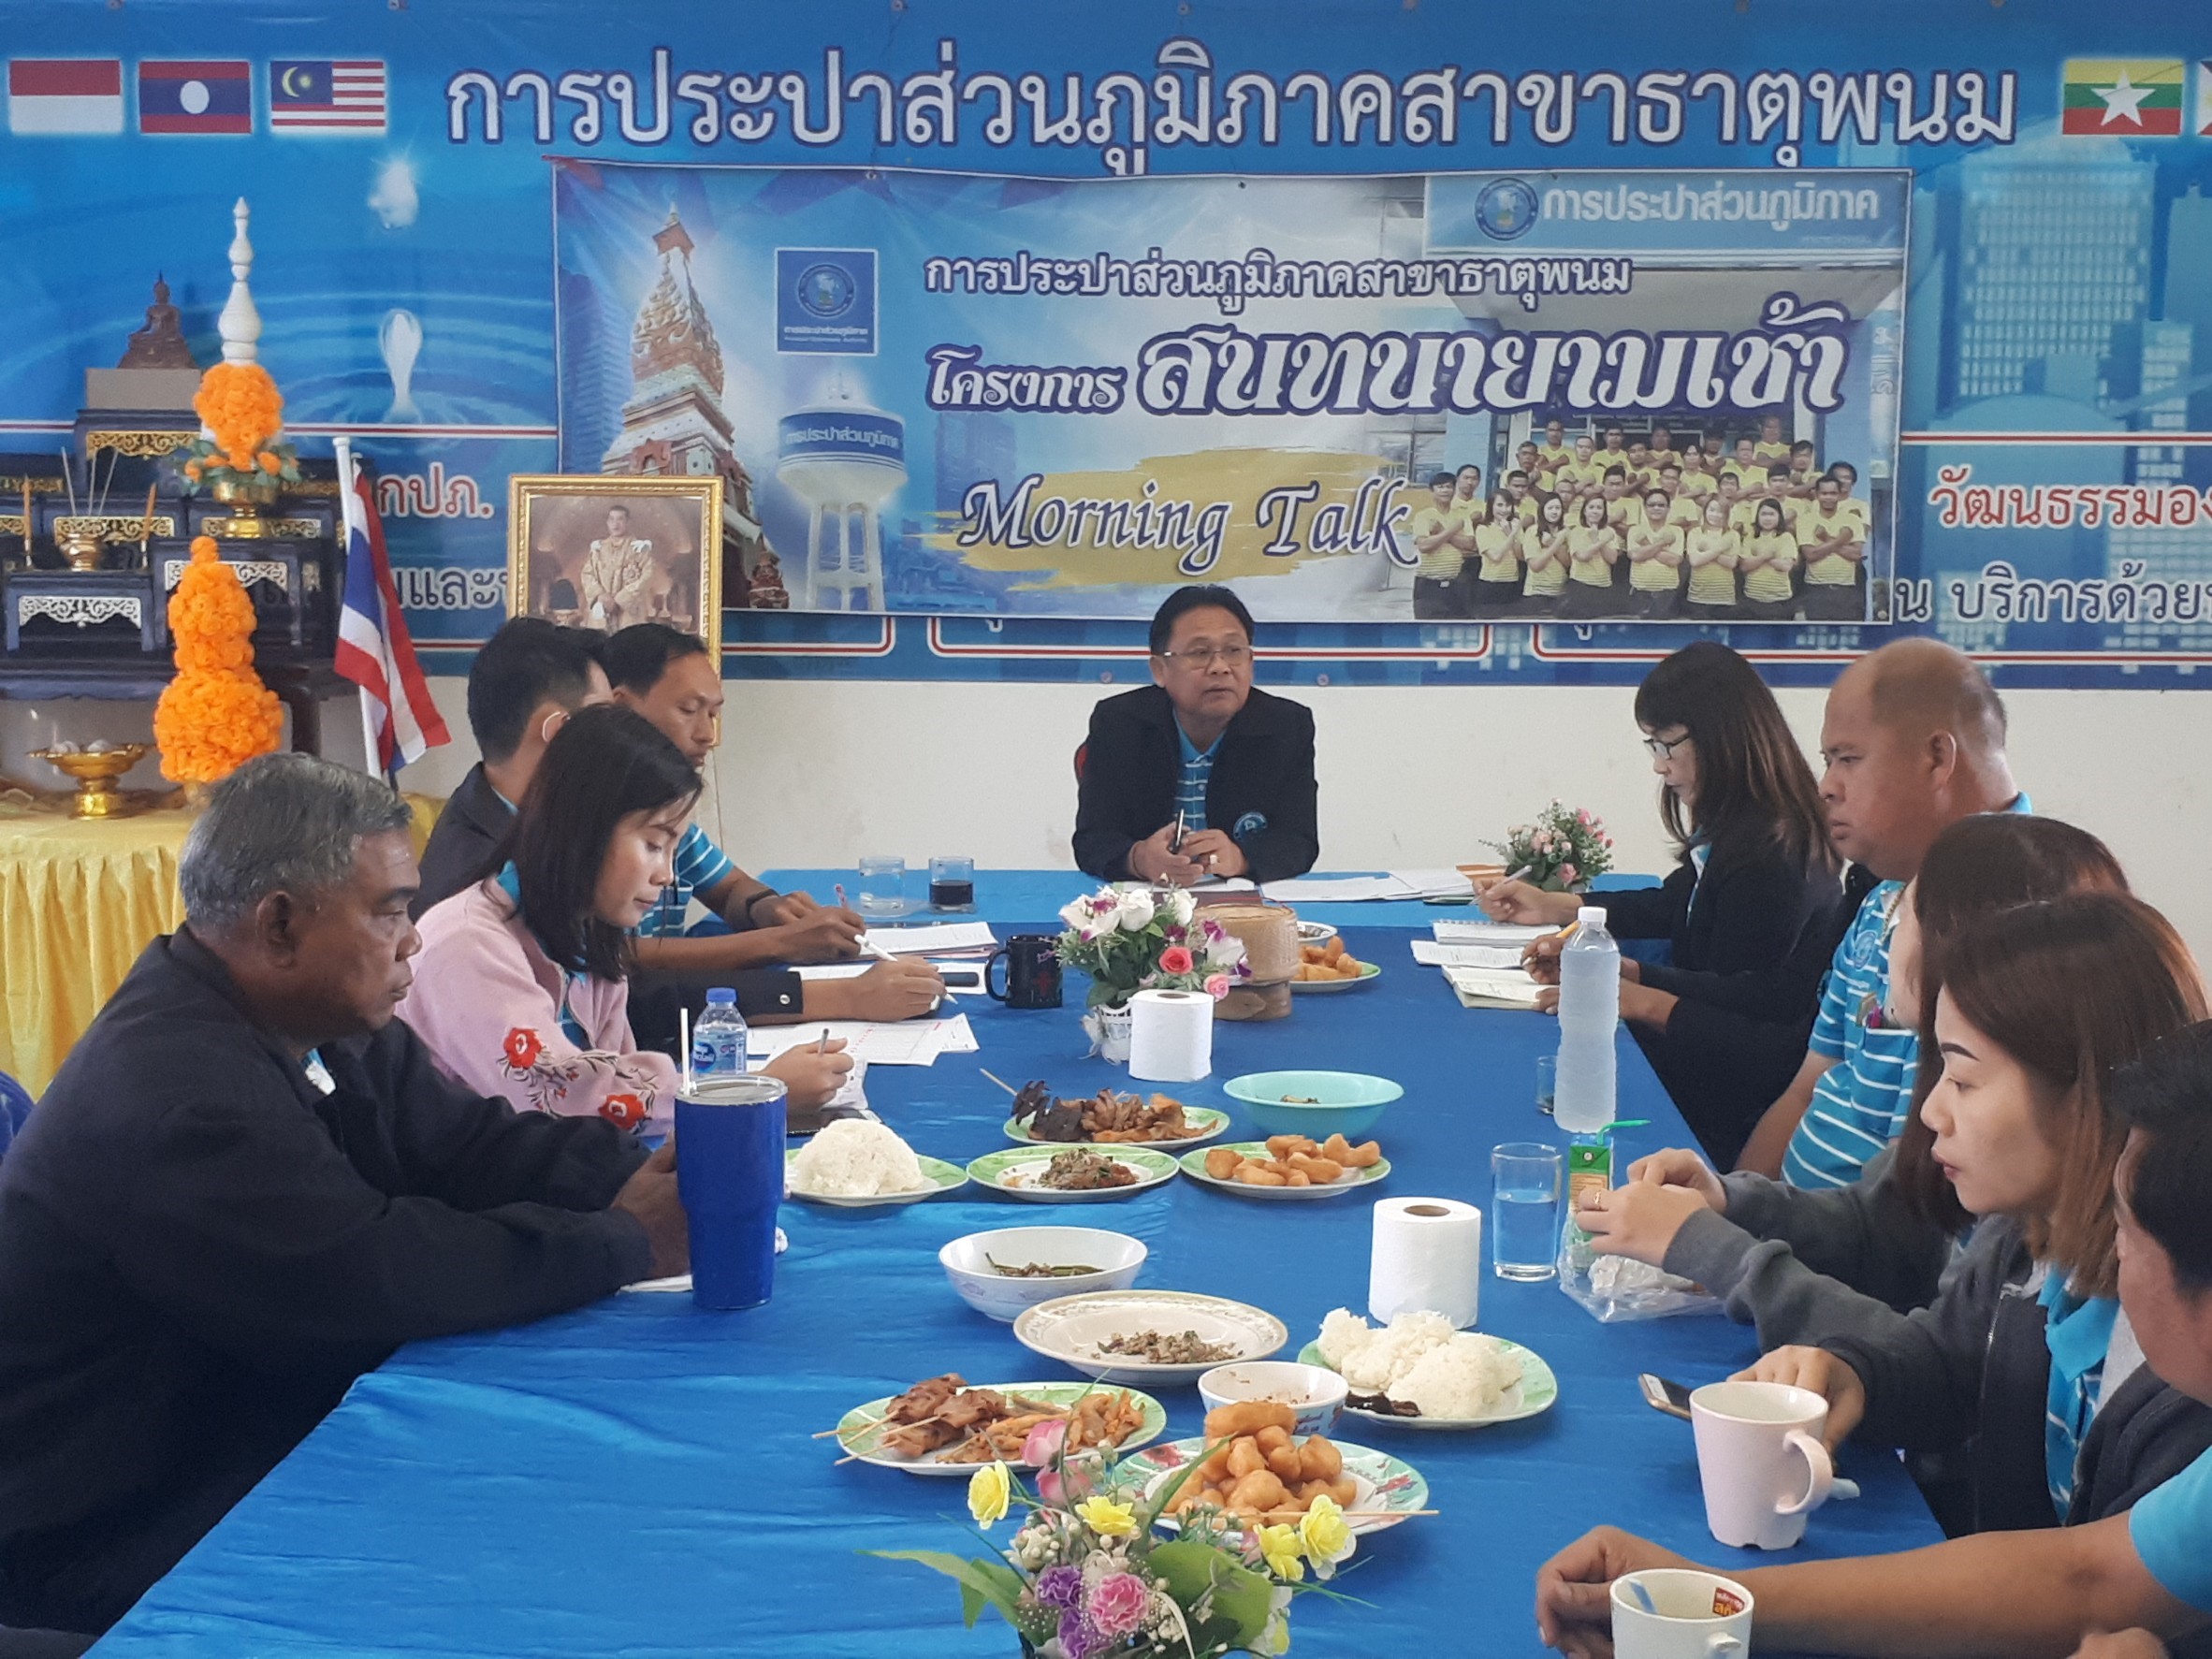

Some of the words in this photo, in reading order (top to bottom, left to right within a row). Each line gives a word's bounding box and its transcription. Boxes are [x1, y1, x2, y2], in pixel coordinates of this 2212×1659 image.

[446, 38, 2017, 177] การประปาส่วนภูมิภาคสาขาธาตุพนม
[1542, 180, 1880, 232] การประปาส่วนภูมิภาค
[924, 247, 1633, 315] การประปาส่วนภูมิภาคสาขาธาตุพนม
[925, 343, 1128, 414] โครงการ
[1137, 291, 1850, 416] สนทนายามเช้า
[956, 473, 1233, 575] Morning
[1256, 475, 1421, 568] Talk
